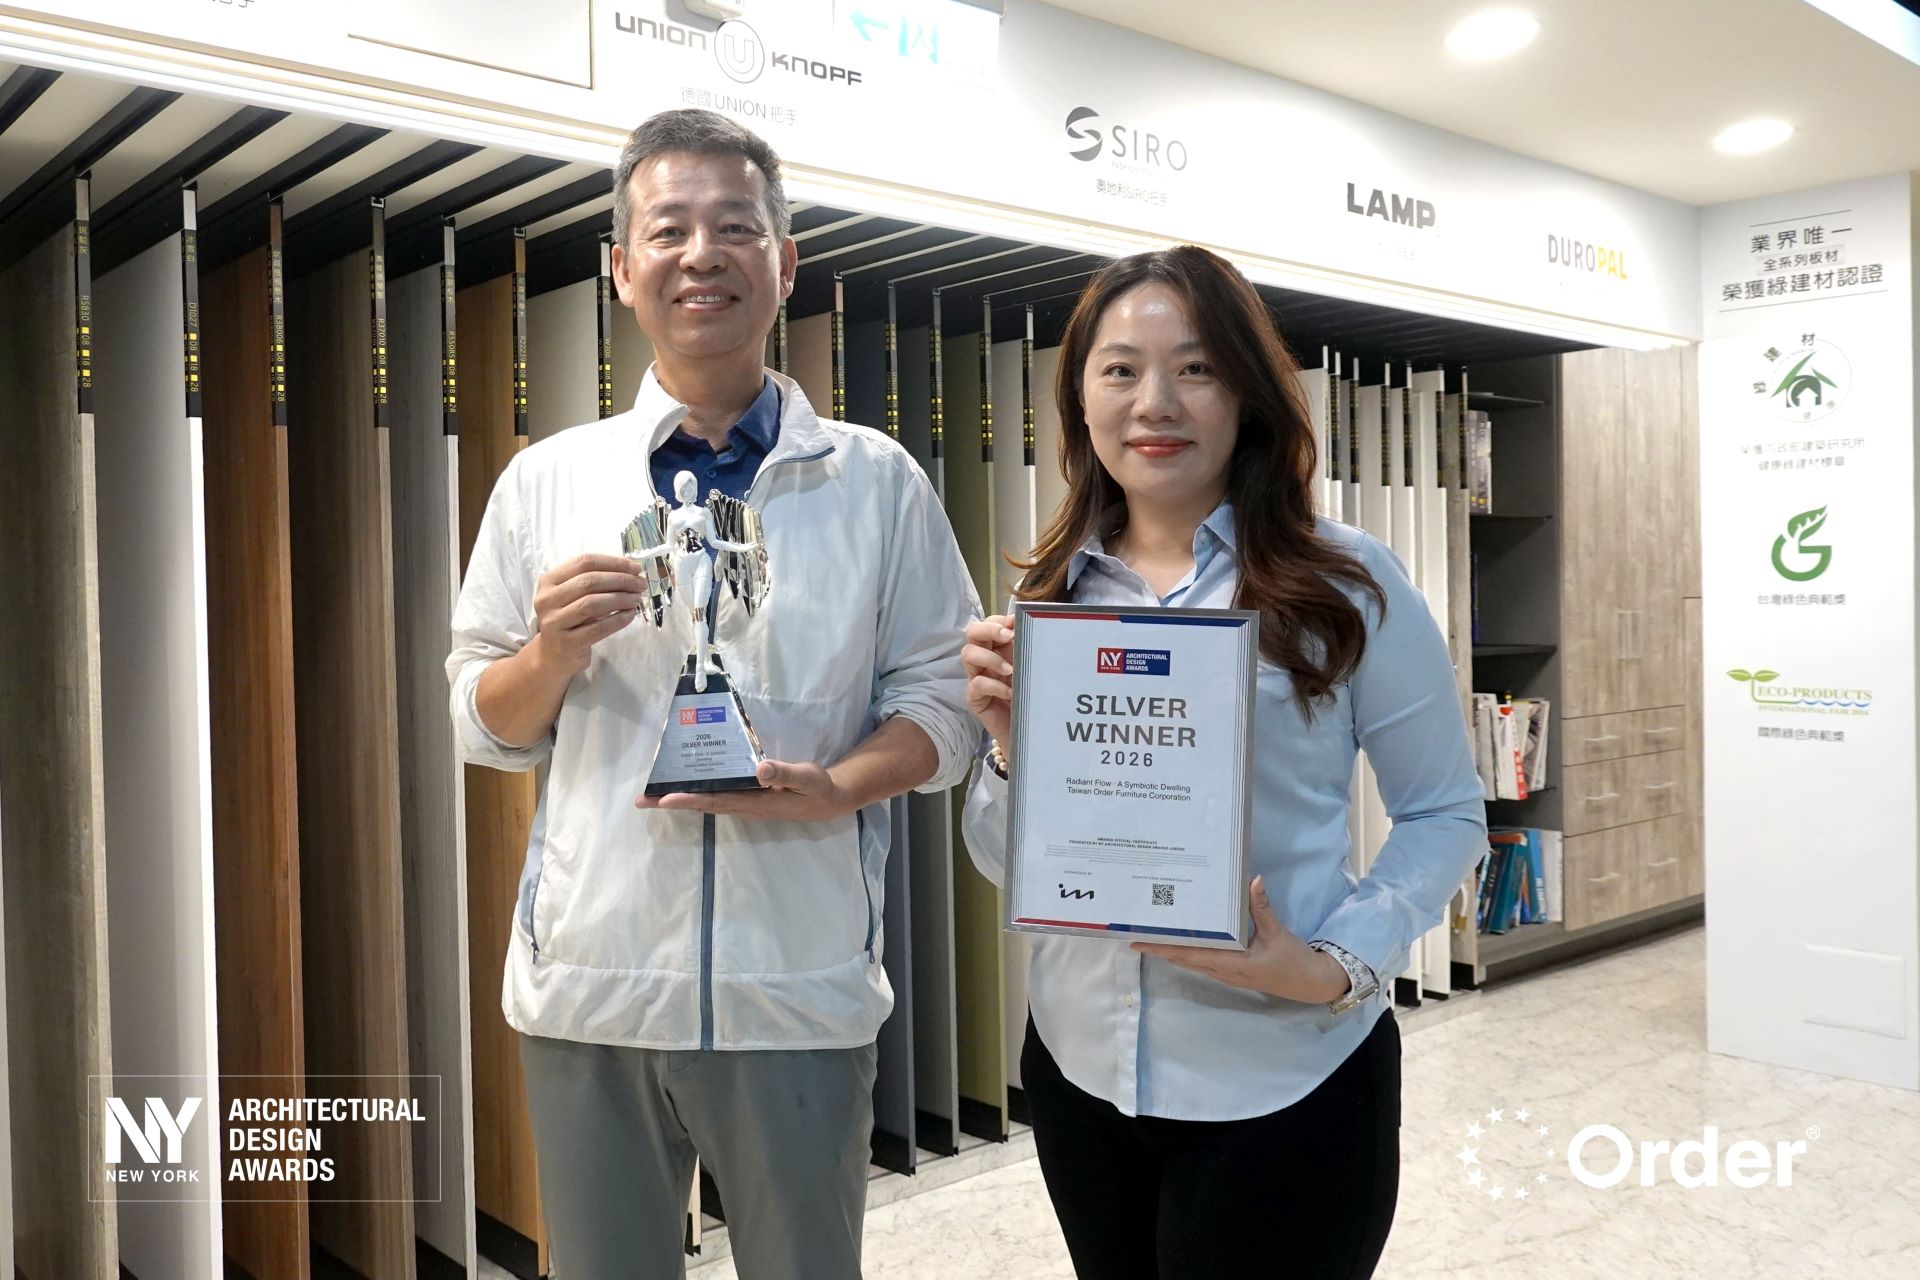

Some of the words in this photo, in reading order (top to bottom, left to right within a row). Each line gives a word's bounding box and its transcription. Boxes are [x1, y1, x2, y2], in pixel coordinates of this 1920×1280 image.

[714, 94, 768, 119] UNION
[770, 105, 798, 126] 把手
[1112, 125, 1187, 171] SIRO
[1347, 182, 1436, 229] LAMP
[1548, 233, 1628, 280] DUROPAL
[1763, 249, 1839, 272] 全系列板材
[1722, 263, 1884, 302] 榮獲綠建材認證
[187, 302, 197, 327] D1027
[82, 335, 90, 345] 08
[378, 318, 387, 346] R37010
[189, 340, 198, 351] 08
[83, 358, 91, 366] 18
[190, 362, 198, 371] 18
[379, 355, 386, 365] 08
[83, 377, 92, 388] 28
[190, 381, 199, 392] 28
[380, 375, 387, 384] 18
[278, 391, 285, 402] 28
[380, 394, 387, 404] 28
[450, 403, 457, 413] 28
[1100, 651, 1122, 667] NY
[1126, 652, 1168, 661] ARCHITECTURAL
[1758, 685, 1872, 701] ECO-PRODUCTS
[1076, 694, 1187, 718] SILVER
[1066, 721, 1197, 748] WINNER
[1100, 750, 1153, 767] 2026
[1066, 777, 1093, 786] Radiant
[1095, 779, 1112, 787] Flow
[1117, 780, 1123, 788] A
[1124, 781, 1158, 790] Symbiotic
[1160, 783, 1191, 793] Dwelling
[1068, 787, 1092, 795] Taiwan
[1093, 788, 1114, 796] Order
[1116, 790, 1147, 799] Furniture
[1149, 792, 1191, 801] Corporation
